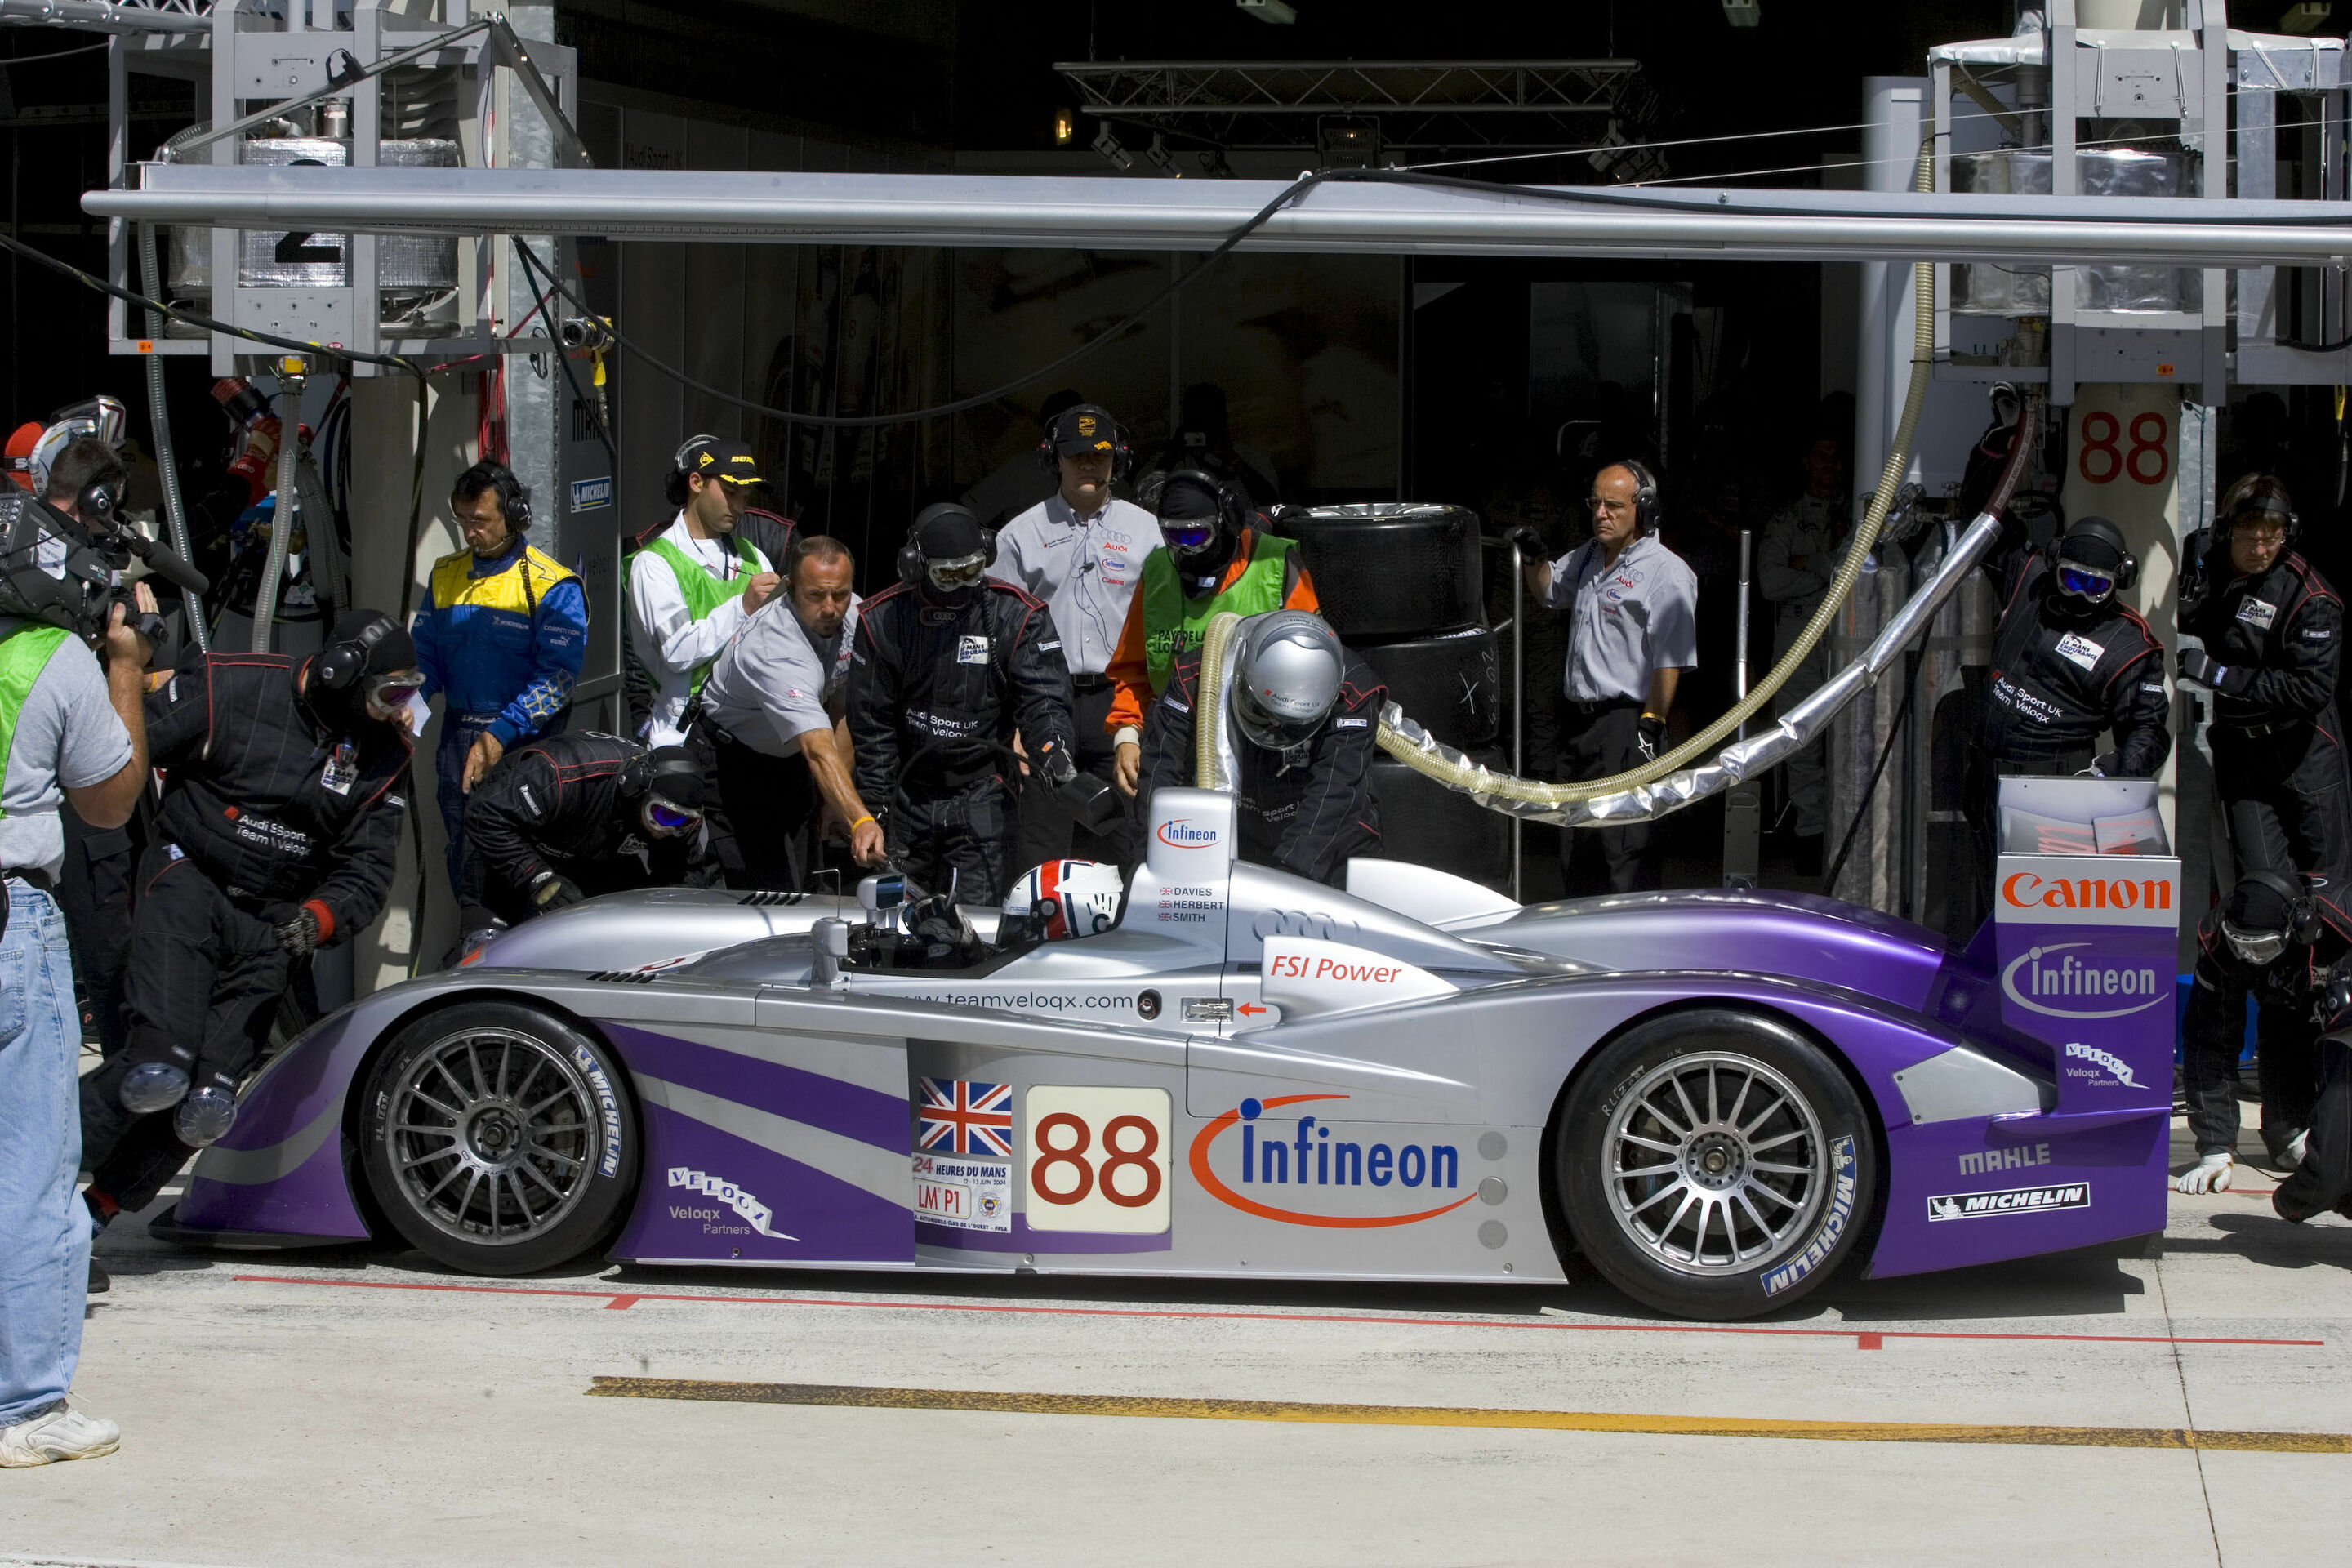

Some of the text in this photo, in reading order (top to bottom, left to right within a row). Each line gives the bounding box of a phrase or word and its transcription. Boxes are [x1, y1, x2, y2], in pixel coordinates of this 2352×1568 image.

[2079, 412, 2167, 484] 88
[581, 483, 609, 502] MICHELIN
[1104, 542, 1127, 552] Audi
[1102, 577, 1124, 586] Canon
[1616, 575, 1634, 589] Audi
[543, 624, 581, 636] COMPETITION
[2060, 643, 2097, 661] ENDURANCE
[2071, 643, 2091, 652] MANS
[1272, 693, 1289, 702] Audi
[1993, 684, 2050, 724] Team Veloqx
[1998, 677, 2064, 718] Audi Sport UK
[905, 715, 929, 731] Team
[906, 708, 978, 730] Audi Sport UK
[238, 815, 269, 831] Audi
[1167, 820, 1217, 842] Infineon
[236, 825, 269, 845] Team
[1174, 887, 1212, 897] DAVIES
[2002, 872, 2170, 909] Canon
[1173, 900, 1224, 911] HERBERT
[1173, 912, 1205, 922] SMITH
[1271, 956, 1402, 985] FSI Power
[2029, 946, 2155, 995] Infineon
[2066, 1067, 2100, 1079] Veloqx
[2087, 1079, 2119, 1087] Partners
[590, 1071, 621, 1174] MICHELIN
[1240, 1098, 1458, 1188] Infineon
[911, 1156, 1007, 1178] 24 HEURES DU MANS
[1031, 1112, 1161, 1207] 88
[1959, 1143, 2051, 1176] MAHLE
[944, 1189, 960, 1214] P1
[1964, 1187, 2082, 1212] MICHELIN
[670, 1205, 721, 1222] Veloqx
[703, 1223, 751, 1235] Partners
[920, 1216, 947, 1225] AUTOMOBILE
[968, 1223, 989, 1231] L'OUEST
[1770, 1177, 1854, 1295] MICHELIN
